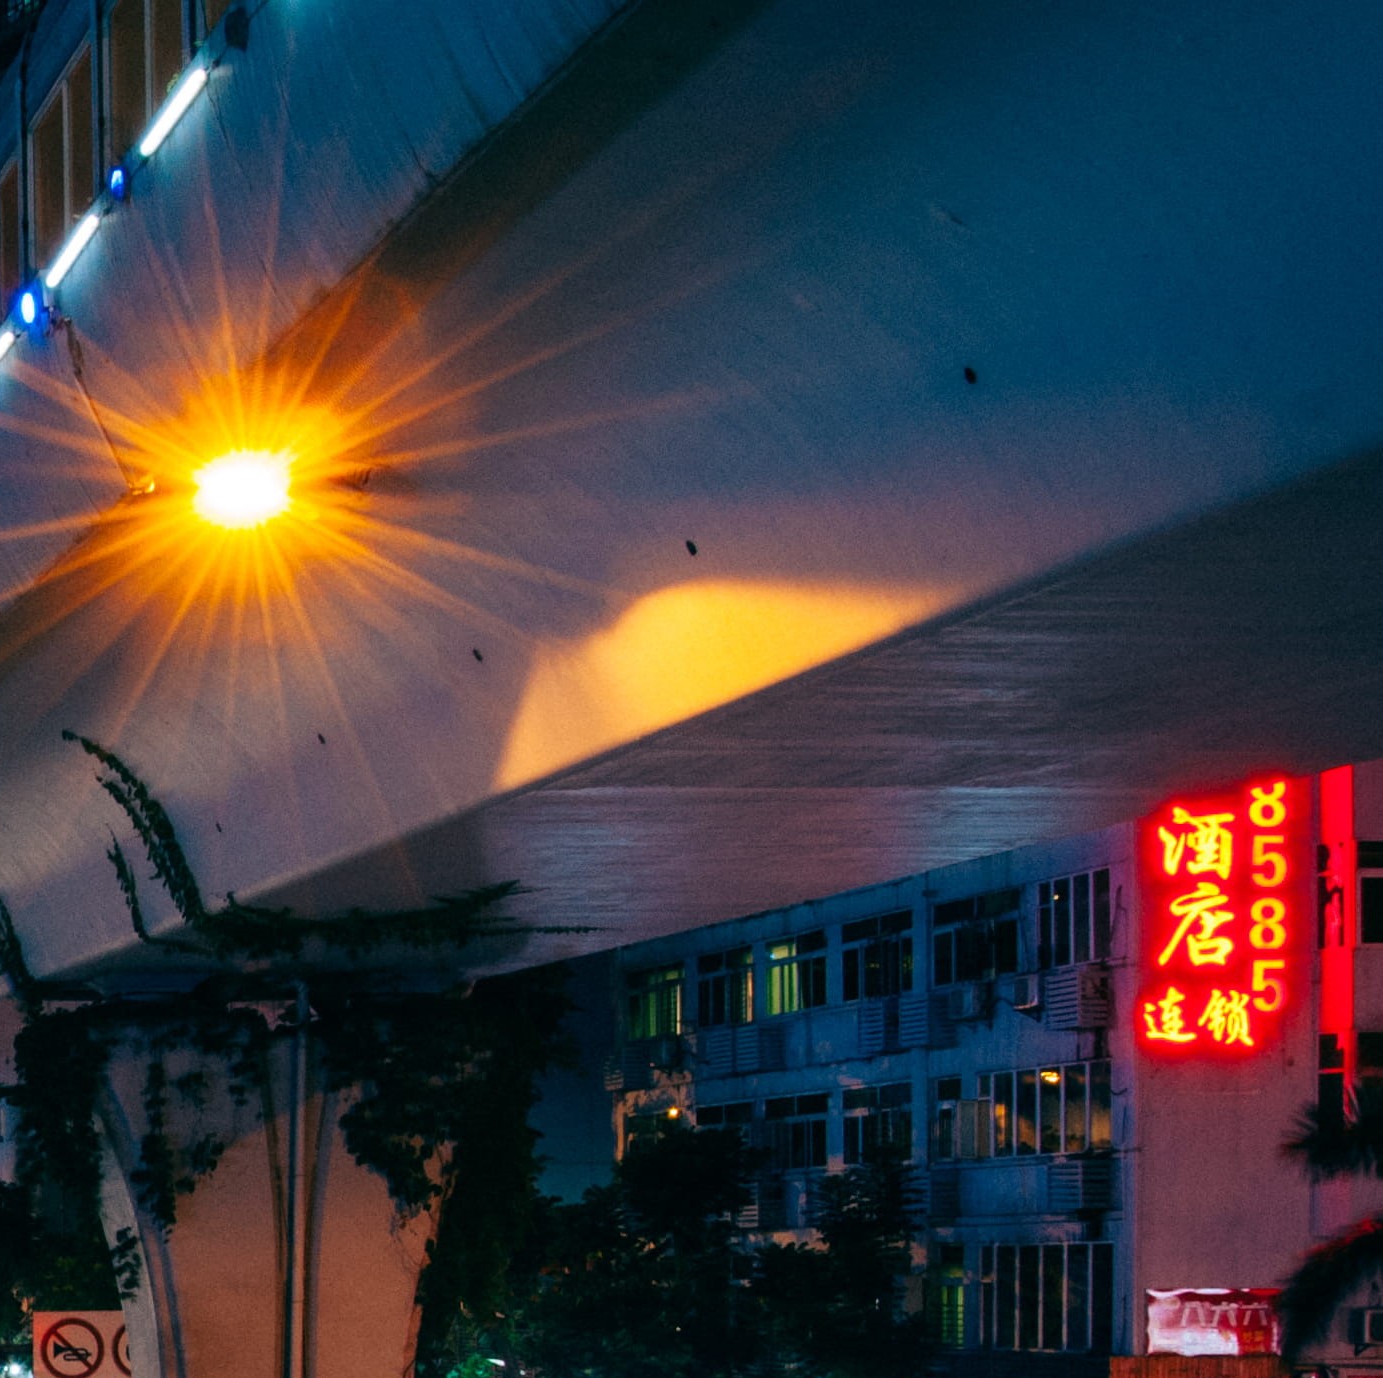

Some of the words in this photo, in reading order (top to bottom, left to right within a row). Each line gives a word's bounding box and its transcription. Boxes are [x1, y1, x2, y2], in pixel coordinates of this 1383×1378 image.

[1157, 806, 1235, 966] 酒店
[1249, 782, 1288, 1012] 8585
[1143, 986, 1254, 1046] 连锁
